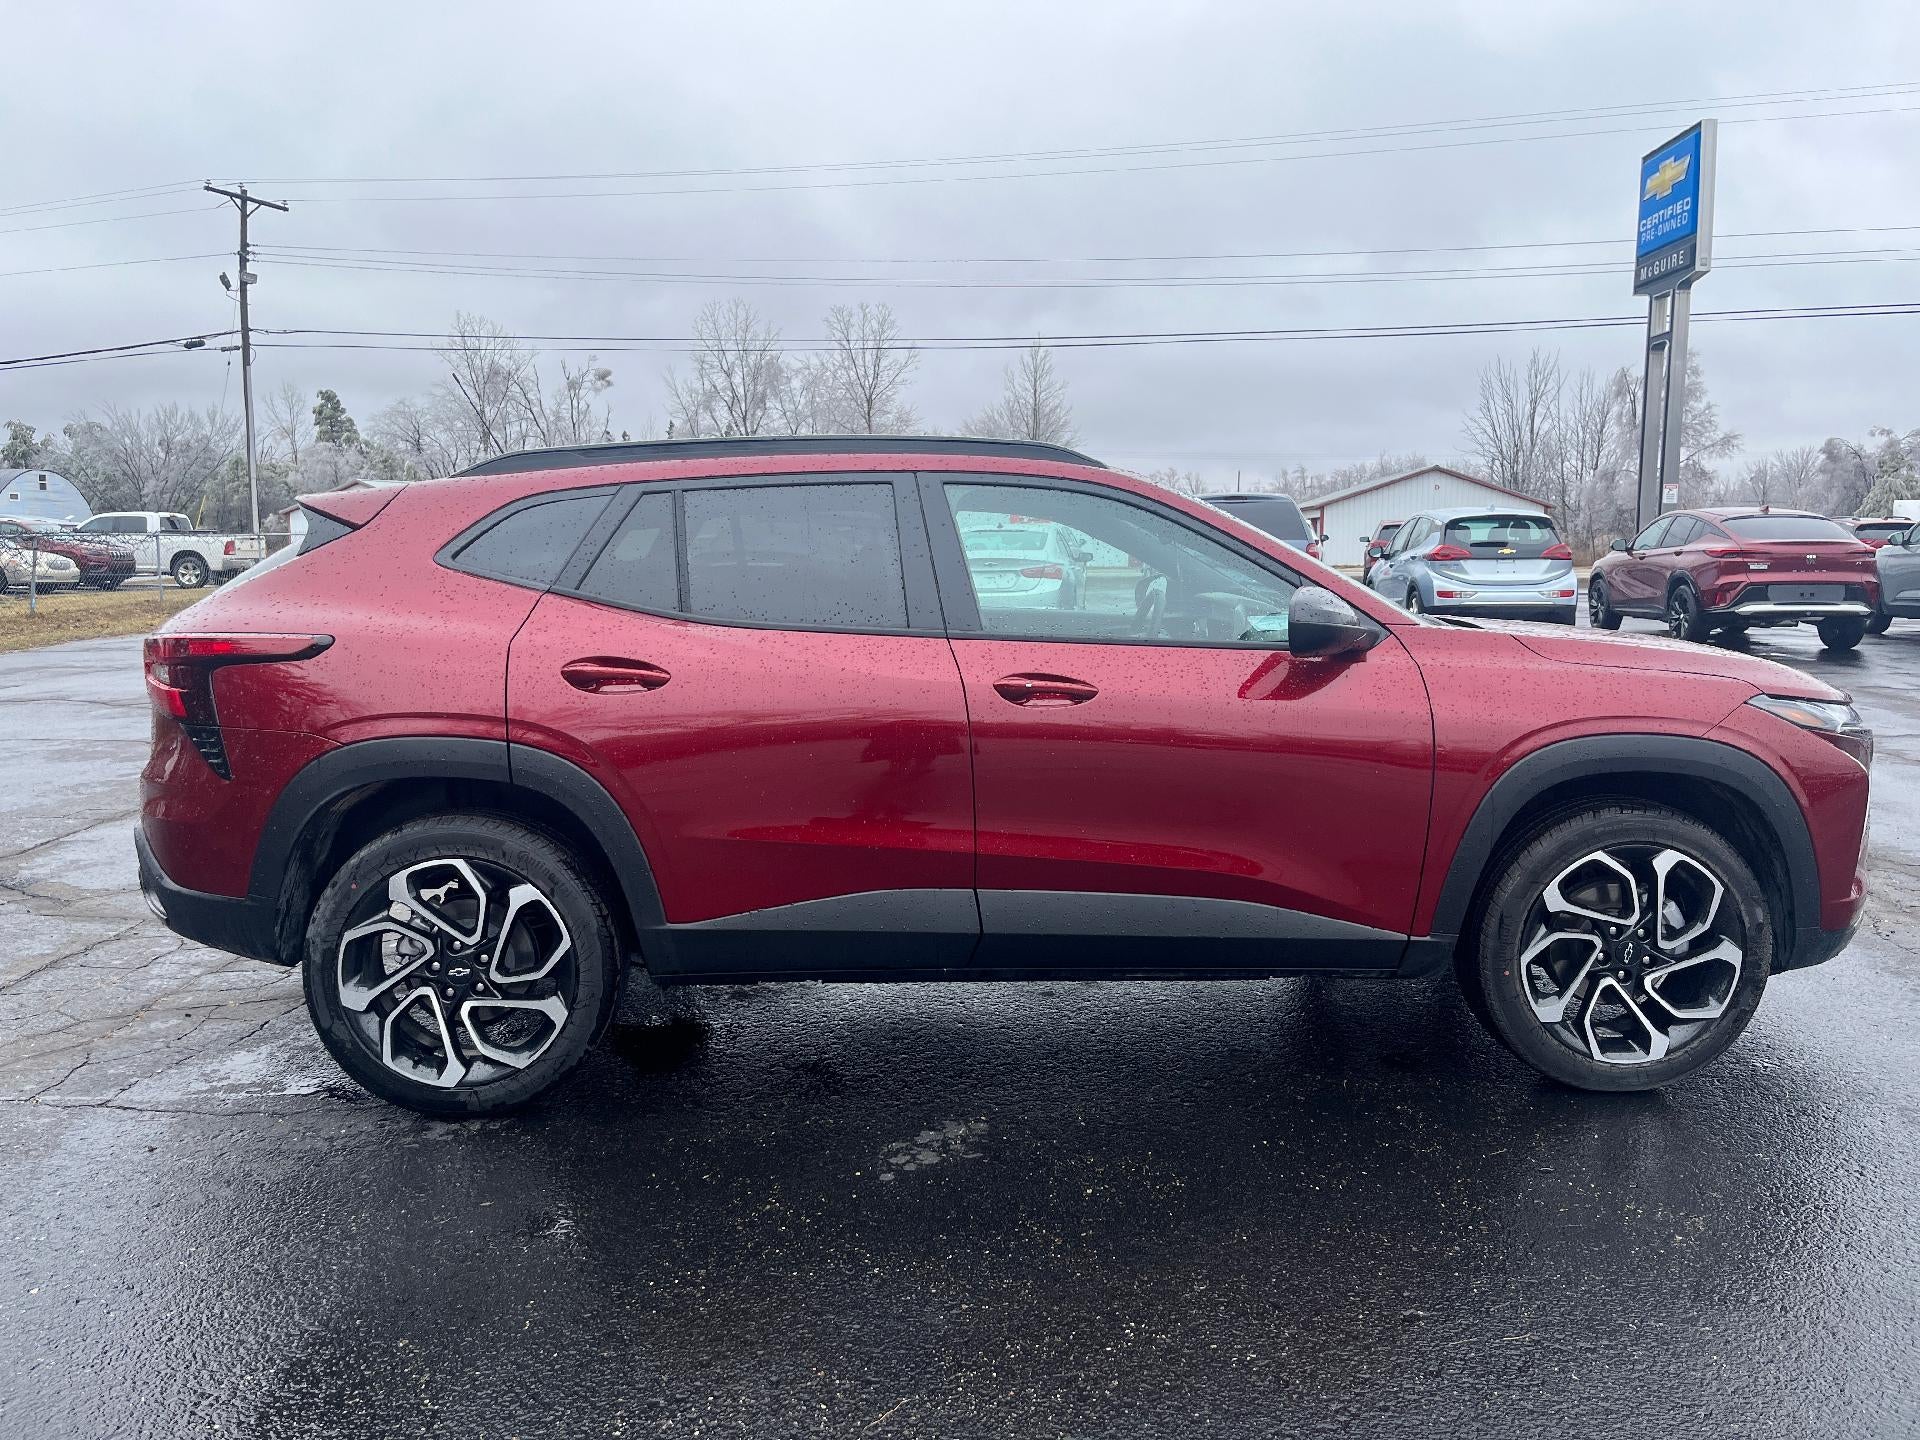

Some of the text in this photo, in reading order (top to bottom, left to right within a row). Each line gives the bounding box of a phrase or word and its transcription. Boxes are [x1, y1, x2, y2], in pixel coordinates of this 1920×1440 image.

[1640, 197, 1691, 231] CERTIFIED
[1641, 212, 1688, 244] PRE-OWNED
[1640, 250, 1684, 281] McGUIRE
